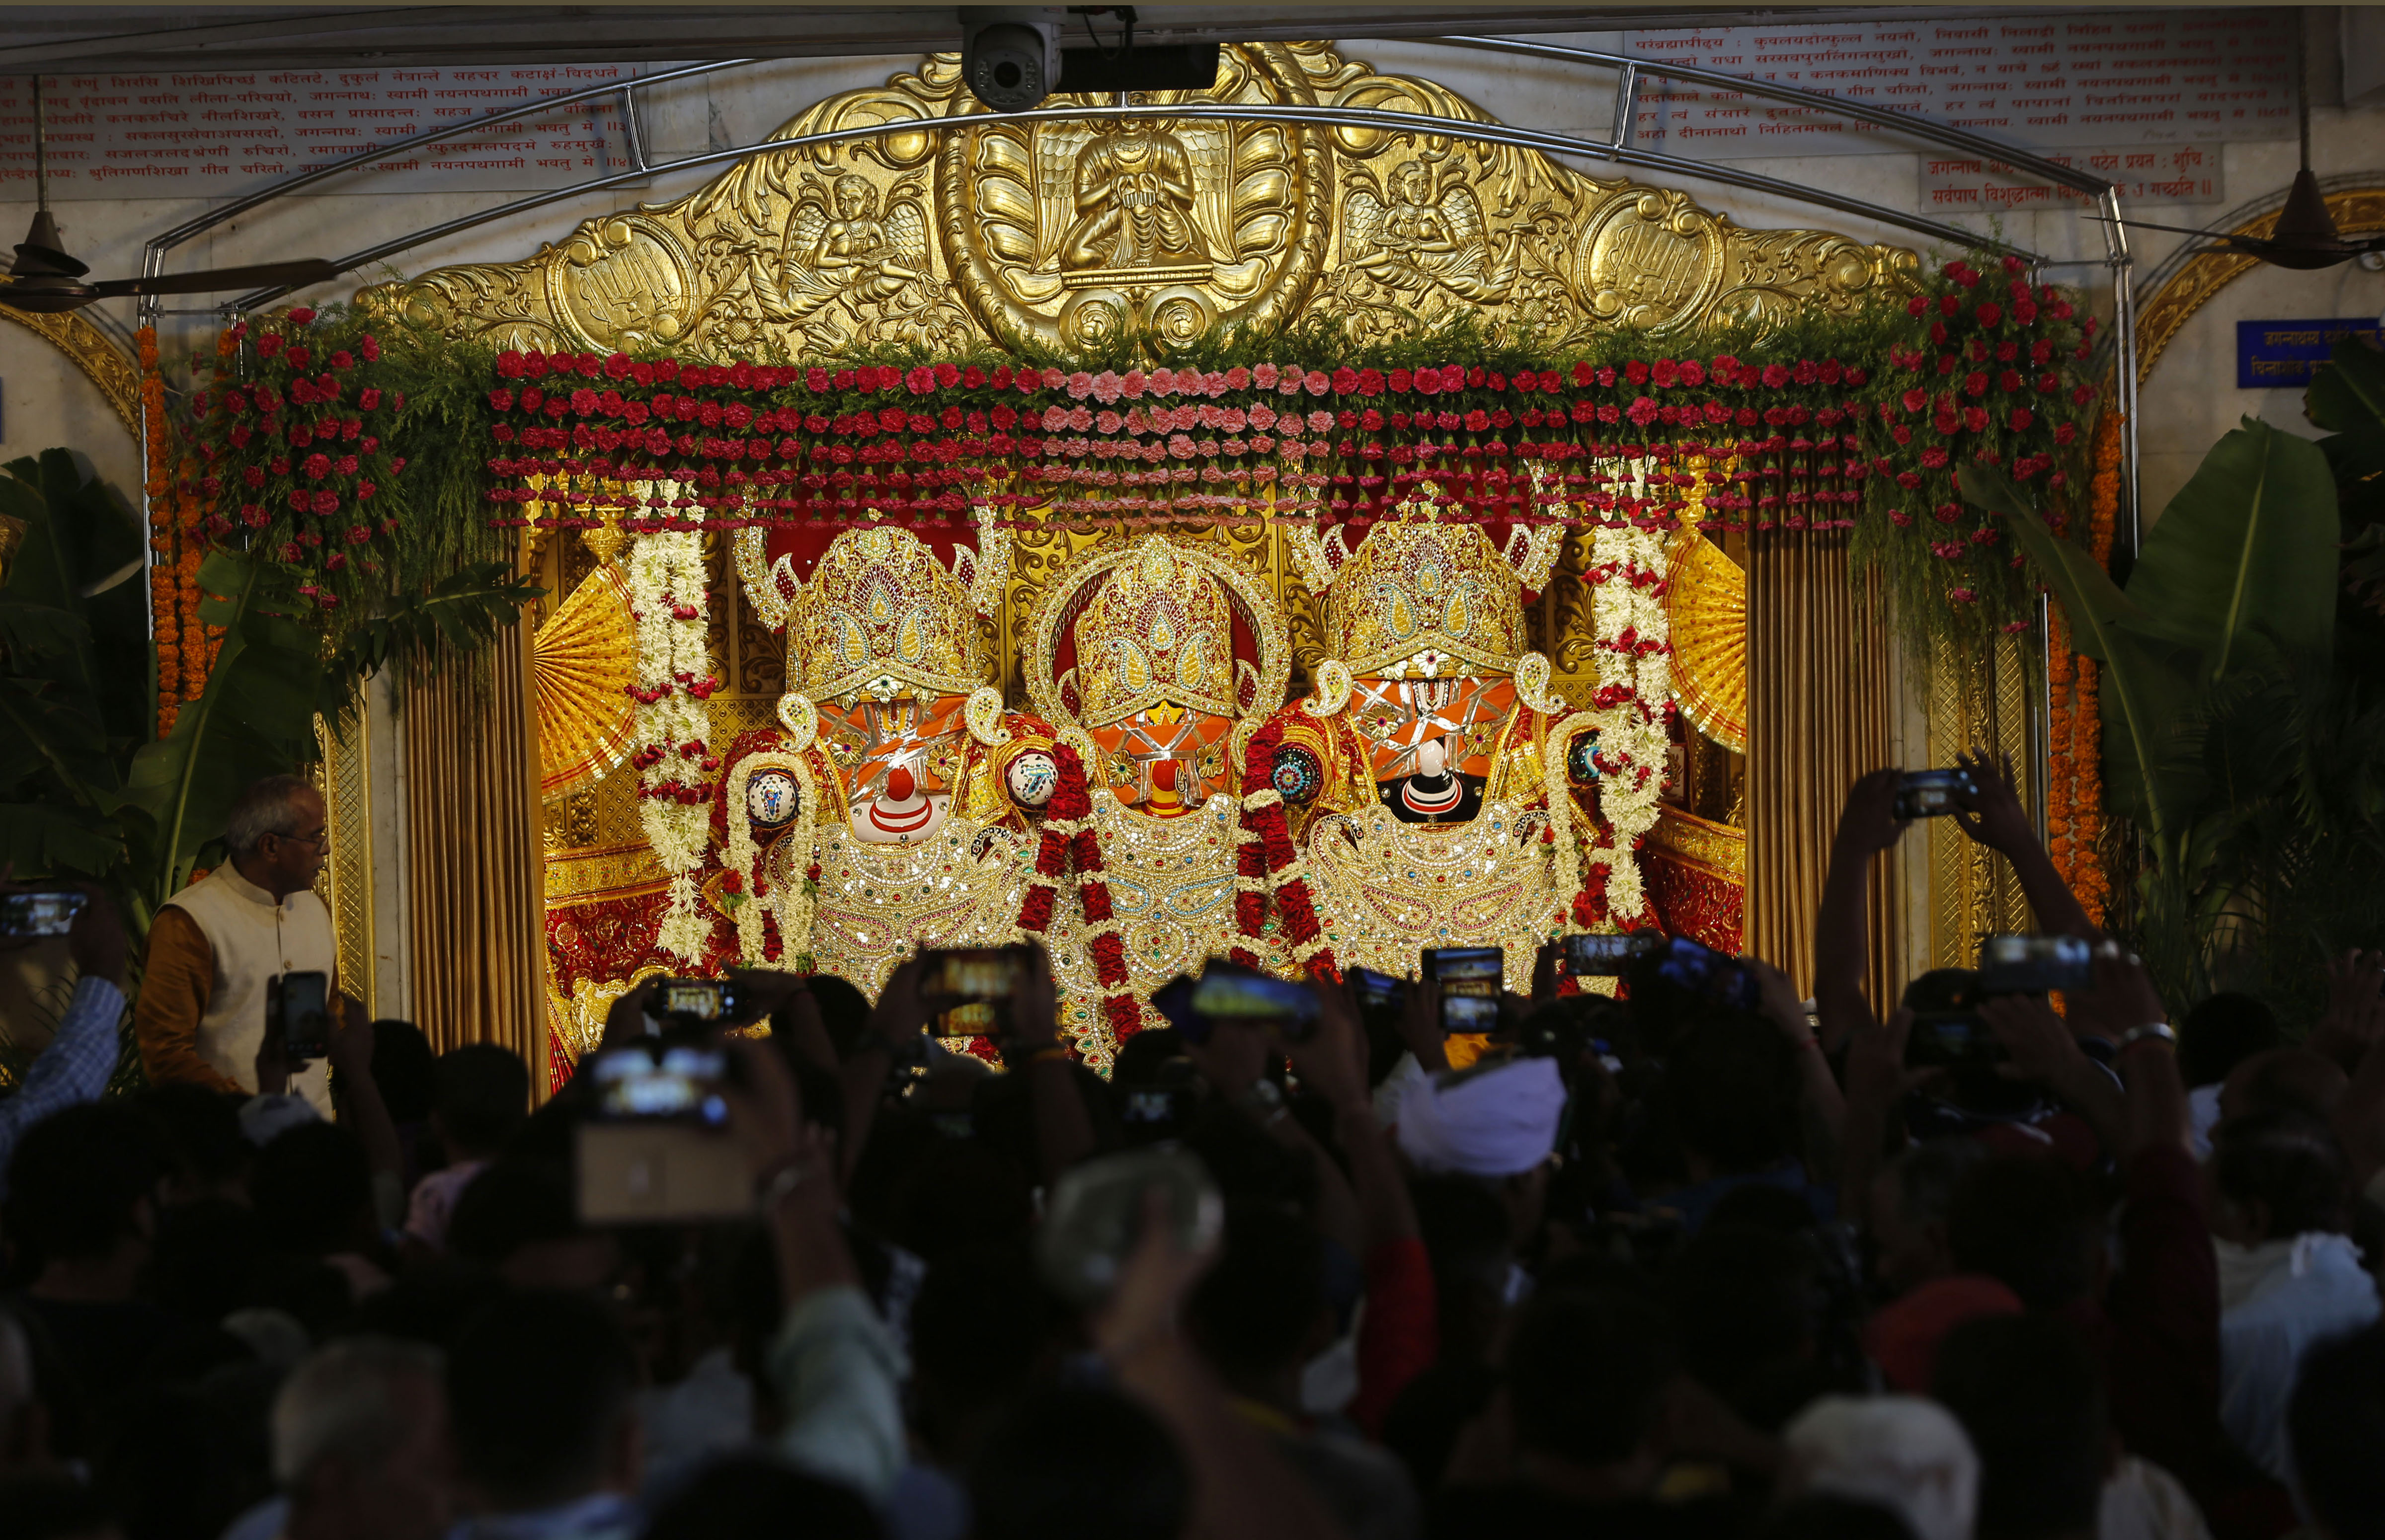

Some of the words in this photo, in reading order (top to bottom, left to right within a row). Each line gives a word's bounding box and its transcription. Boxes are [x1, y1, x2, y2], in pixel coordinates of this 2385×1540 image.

[1875, 29, 1921, 43] नयनो,
[111, 76, 159, 87] शिरसि
[339, 72, 379, 86] दुकुलं
[393, 70, 439, 81] नेत्रान्ते
[454, 72, 499, 81] सहचर
[1765, 73, 1776, 81] न
[1787, 72, 1800, 80] च
[140, 93, 179, 104] वसति
[388, 88, 428, 99] स्वामी
[434, 86, 528, 98] नयनपथगामी
[1847, 85, 1875, 95] गीत
[1637, 113, 1657, 122] हर
[1672, 110, 1688, 119] त्वं
[375, 124, 416, 135] स्वामी
[535, 124, 570, 135] भवतु
[581, 120, 594, 131] मे
[1638, 130, 1667, 139] अहो
[1679, 127, 1747, 138] दीनानाथो
[1759, 122, 1842, 135] निहितमचलं
[201, 163, 228, 174] गीत
[240, 162, 289, 173] चरितो,
[378, 159, 419, 171] स्वामी
[431, 156, 525, 169] नयनपथगामी
[537, 159, 571, 170] भवतु
[581, 155, 594, 166] मे
[1928, 160, 1982, 174] जगन्नाथ
[1932, 184, 1978, 203] सर्वपाप
